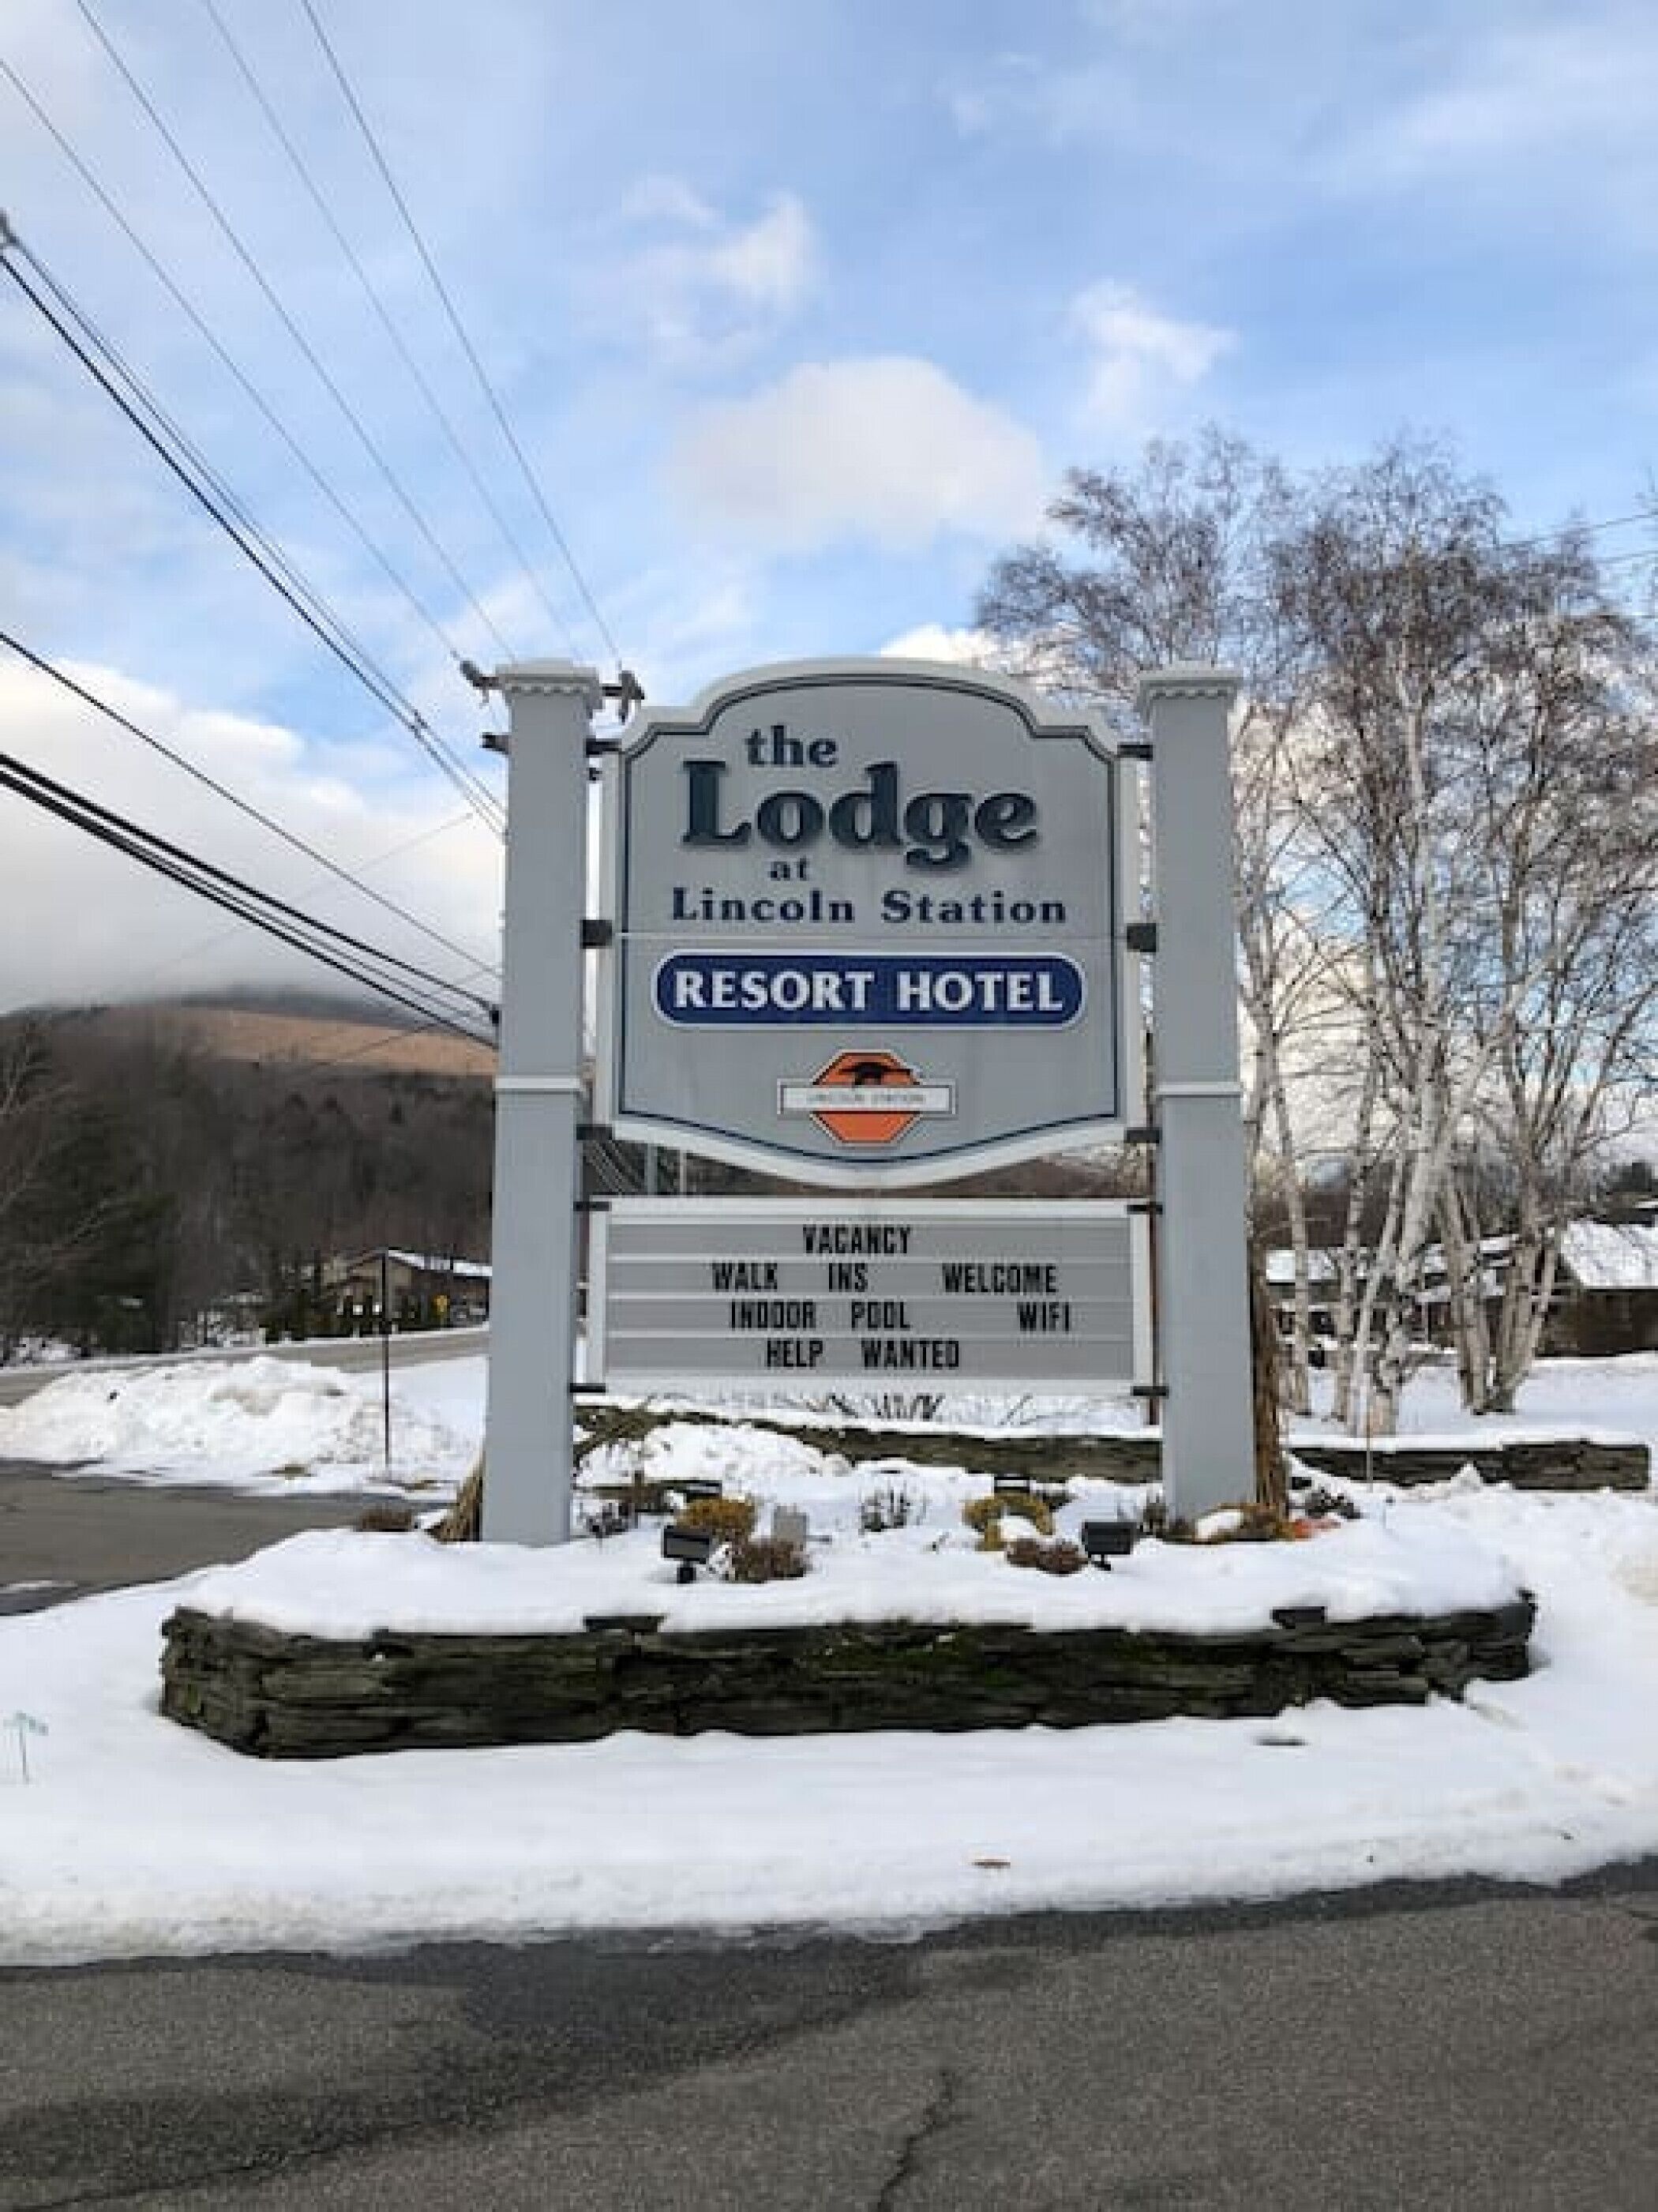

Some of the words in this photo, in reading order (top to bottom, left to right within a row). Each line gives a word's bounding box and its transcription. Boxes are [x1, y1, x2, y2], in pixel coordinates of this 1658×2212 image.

[745, 725, 838, 765] the
[683, 760, 1039, 869] Lodge
[768, 857, 808, 881] at
[673, 888, 855, 922] Lincoln
[881, 889, 1067, 923] Station
[676, 971, 873, 1011] RESORT
[897, 972, 1063, 1012] HOTEL
[803, 1226, 913, 1254] VACANCY
[712, 1263, 778, 1292] WALK
[828, 1263, 868, 1293] INS
[943, 1264, 1057, 1294] WELCOME
[730, 1301, 816, 1328] INDOOR
[851, 1301, 910, 1330] POOL
[1017, 1302, 1071, 1331] WIFI
[766, 1340, 824, 1369] HELP
[861, 1340, 960, 1369] WANTED
